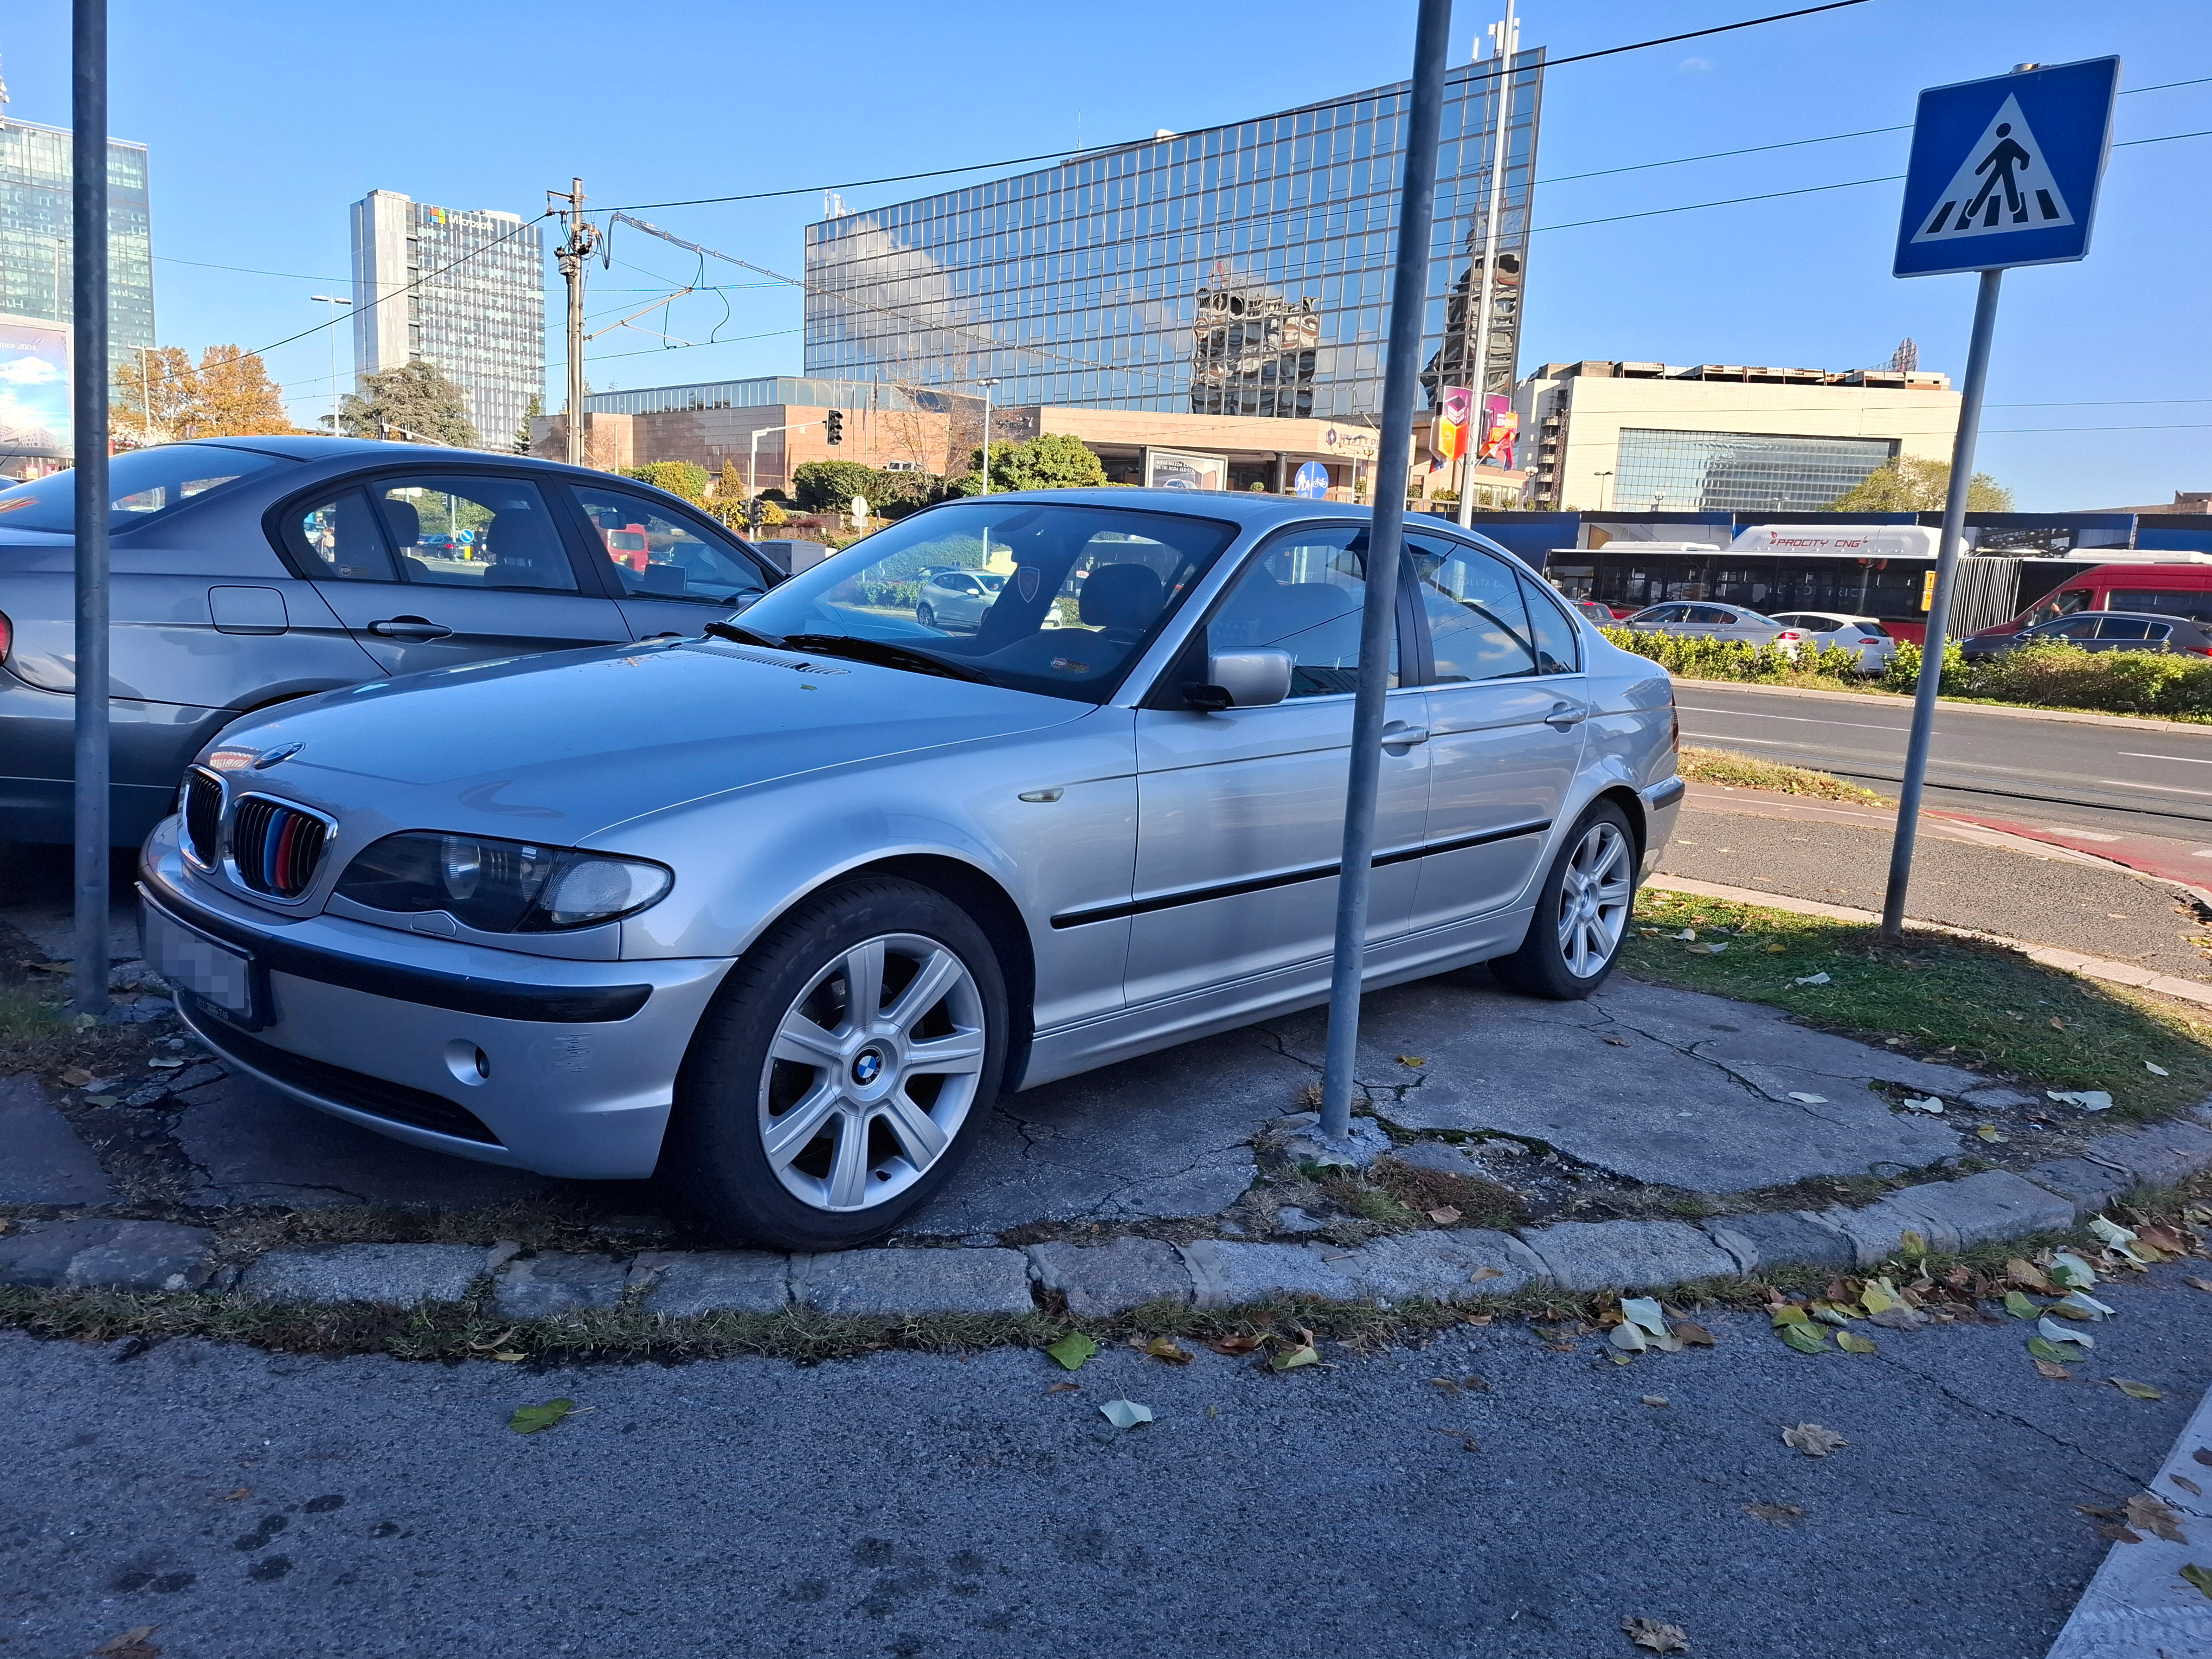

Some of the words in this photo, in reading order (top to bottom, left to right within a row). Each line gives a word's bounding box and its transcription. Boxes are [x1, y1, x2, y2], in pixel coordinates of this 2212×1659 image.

[448, 214, 494, 232] Microsoft
[17, 343, 37, 351] 2004
[1776, 539, 1829, 547] PROCITY
[1834, 539, 1862, 548] CNG
